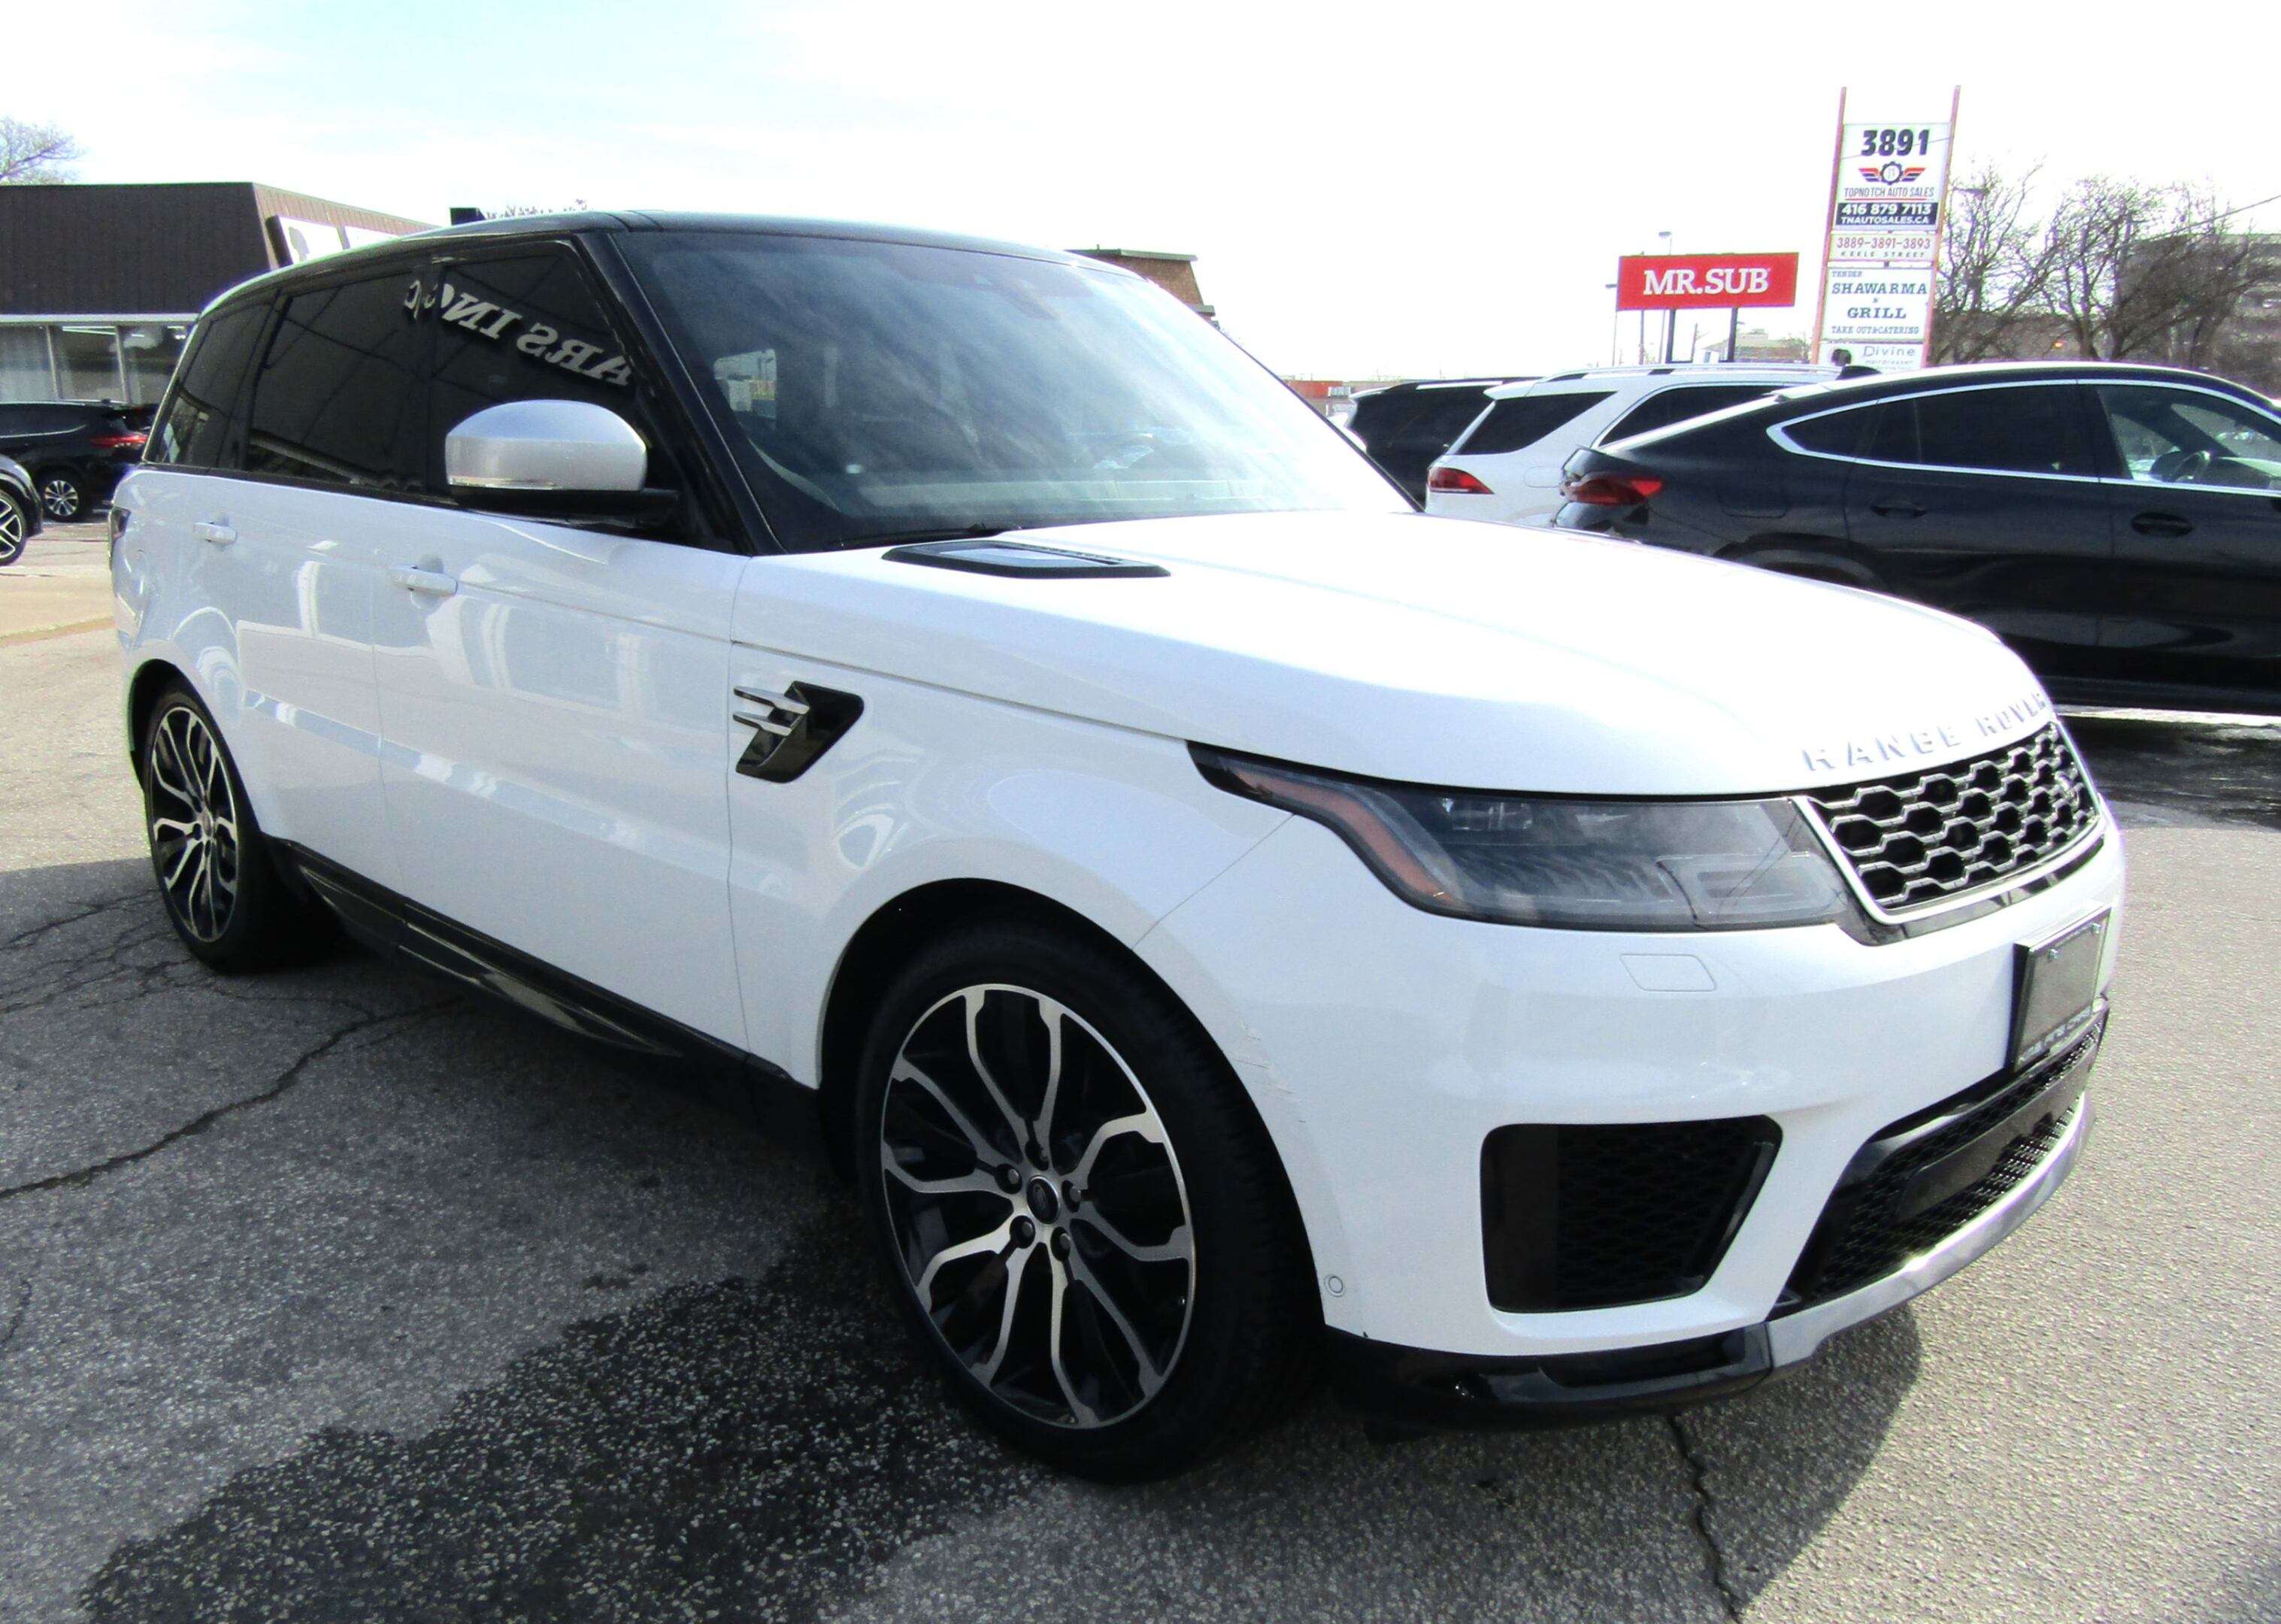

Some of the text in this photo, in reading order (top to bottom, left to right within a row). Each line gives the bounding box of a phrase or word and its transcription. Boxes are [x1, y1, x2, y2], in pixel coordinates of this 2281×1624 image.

[1861, 129, 1930, 156] 3891
[1844, 186, 1934, 198] TOPNOTCH AUTO SALES
[1842, 203, 1931, 215] 416 879 7113
[1841, 216, 1929, 224] TNAUTOSALES.CA
[1837, 237, 1931, 249] 3889-3891-3893
[1643, 268, 1769, 295] MR.SUB
[1831, 283, 1928, 294] SHAWARMA
[1847, 307, 1907, 319] GRILL
[1831, 326, 1853, 334] TAKE
[1863, 345, 1915, 357] Divine
[1801, 723, 1961, 771] RANGE
